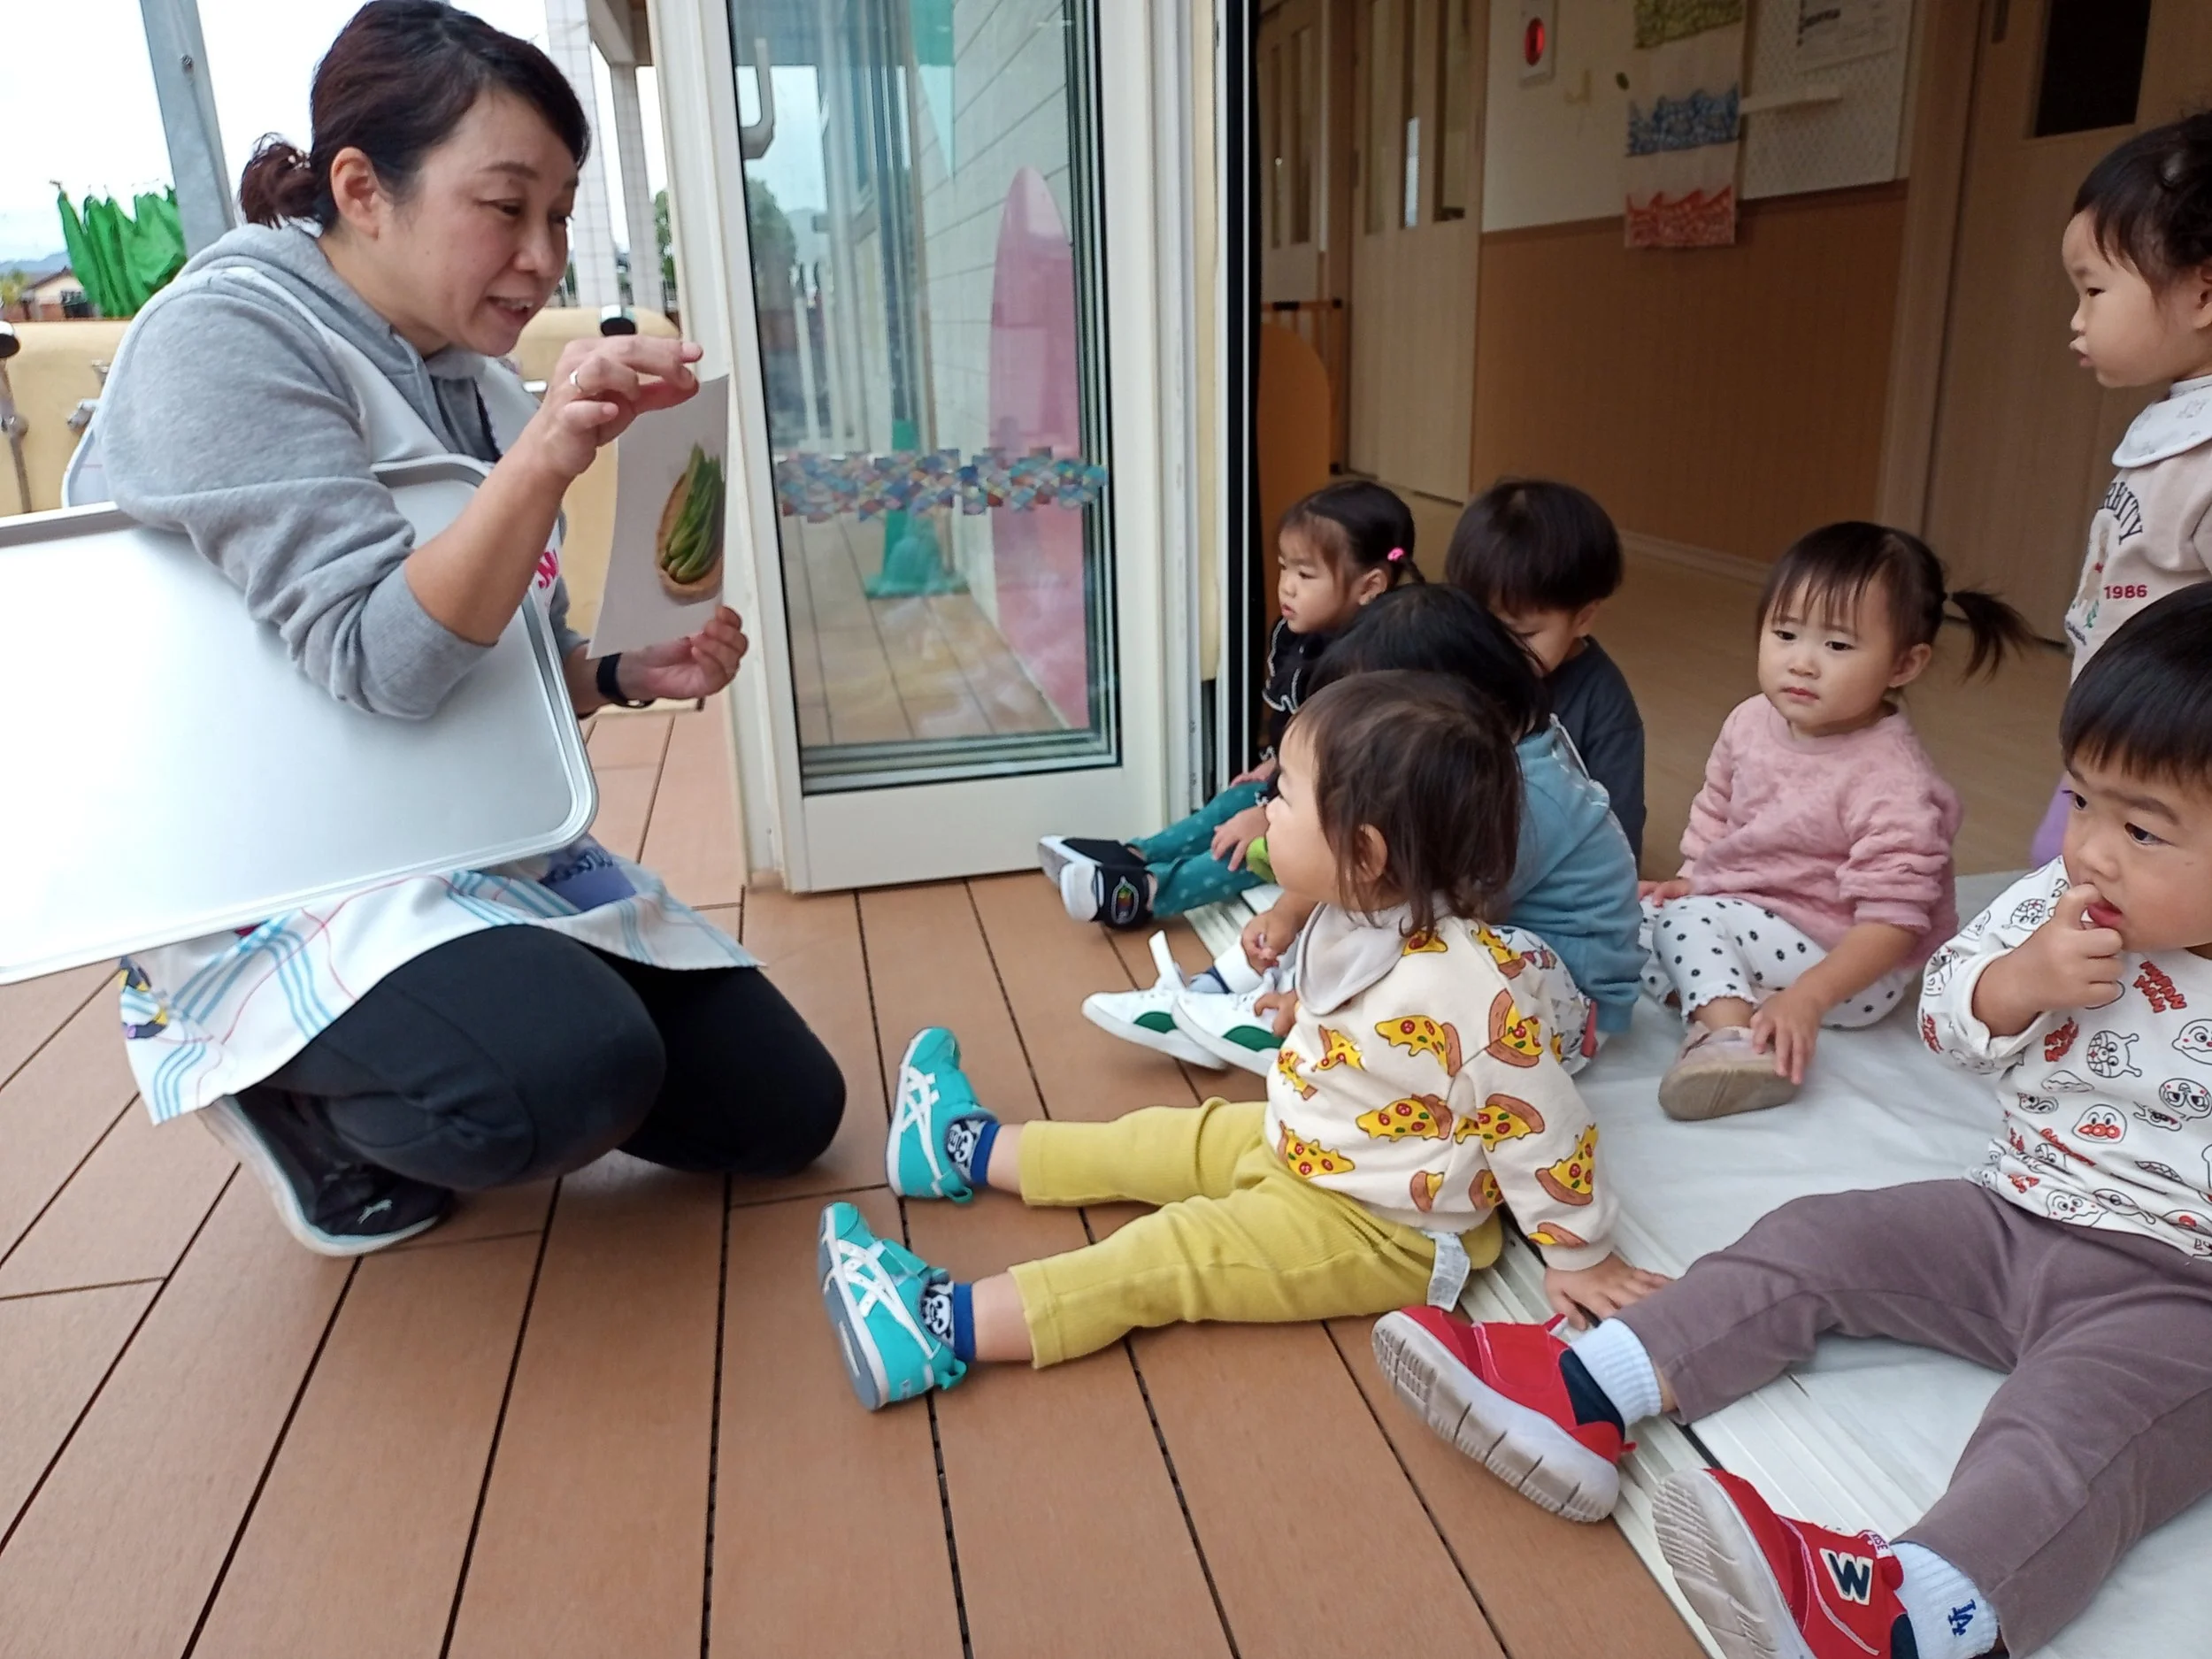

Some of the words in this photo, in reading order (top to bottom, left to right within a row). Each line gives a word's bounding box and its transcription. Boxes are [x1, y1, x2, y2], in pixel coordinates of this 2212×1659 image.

[2103, 584, 2147, 600] 1986
[1821, 1549, 1872, 1604] W
[1948, 1599, 1976, 1636] LA
